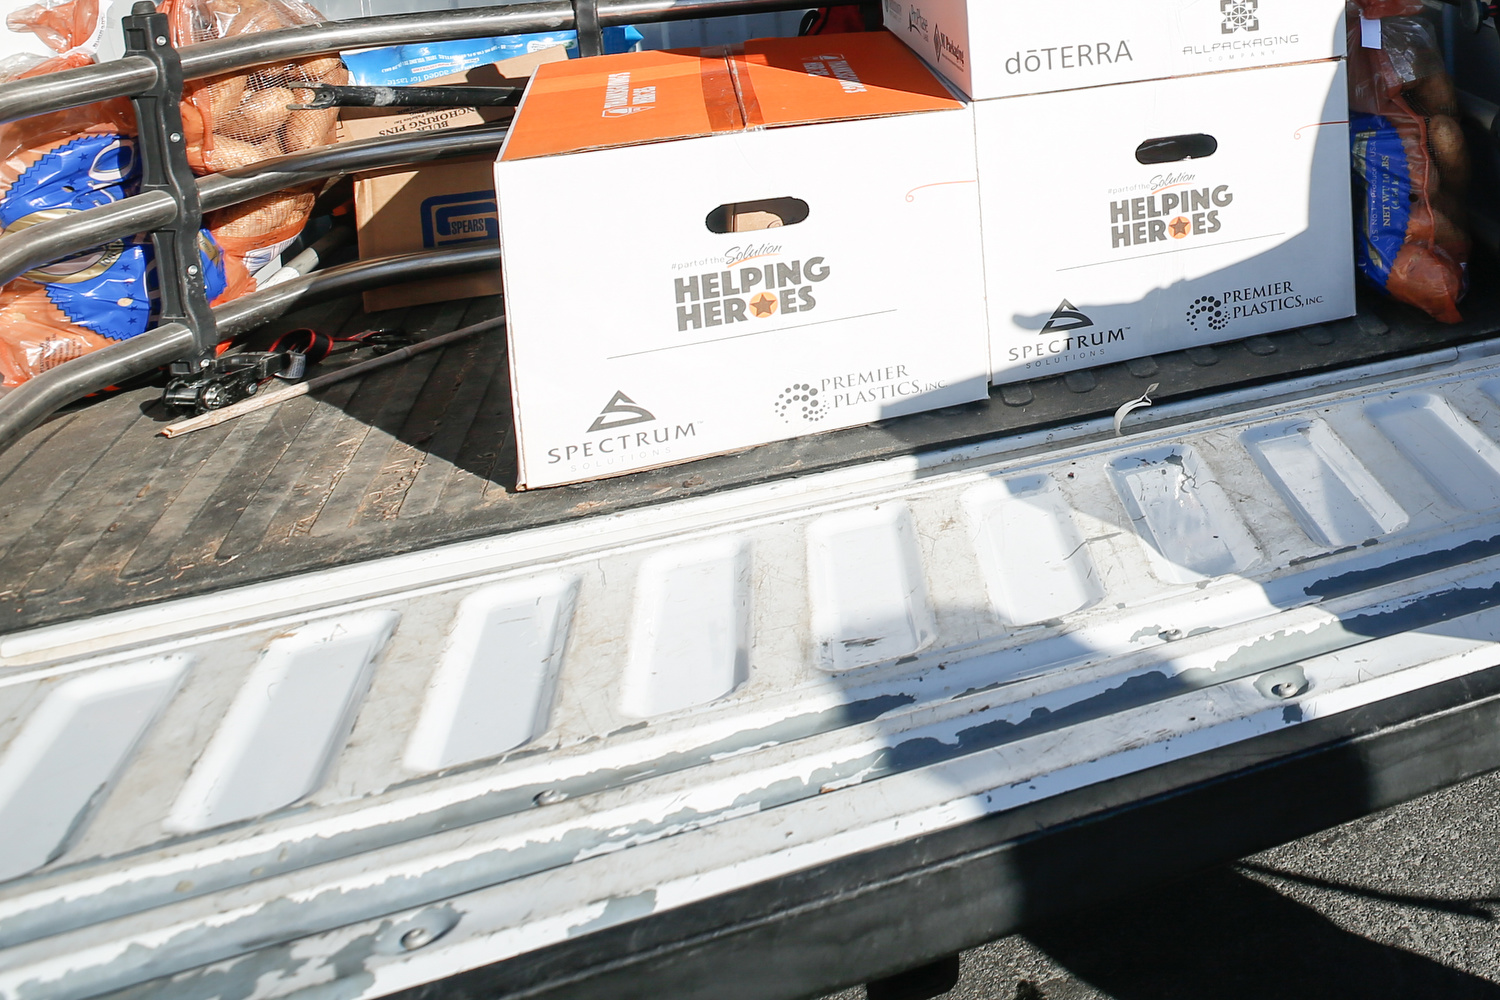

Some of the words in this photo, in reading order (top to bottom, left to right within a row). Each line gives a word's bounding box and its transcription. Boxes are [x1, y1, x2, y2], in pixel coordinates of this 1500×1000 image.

[1208, 50, 1277, 62] COMPANY
[423, 69, 449, 83] added
[409, 107, 476, 130] NCHORING
[378, 123, 407, 137] PINS
[1369, 140, 1377, 158] USA
[1150, 171, 1196, 192] Solution
[1109, 184, 1233, 224] HELPING
[1382, 186, 1391, 203] WT
[451, 217, 485, 235] SPEARS
[1382, 206, 1391, 227] NET
[1111, 210, 1222, 249] HEROES
[725, 242, 783, 265] Solution
[674, 256, 831, 304] HELPING
[1222, 280, 1294, 304] PREMIER
[676, 285, 816, 332] HEROES
[1025, 347, 1106, 369] SOLUTIONS
[821, 364, 909, 392] PREMIER
[570, 446, 672, 473] SOLUTIONS
